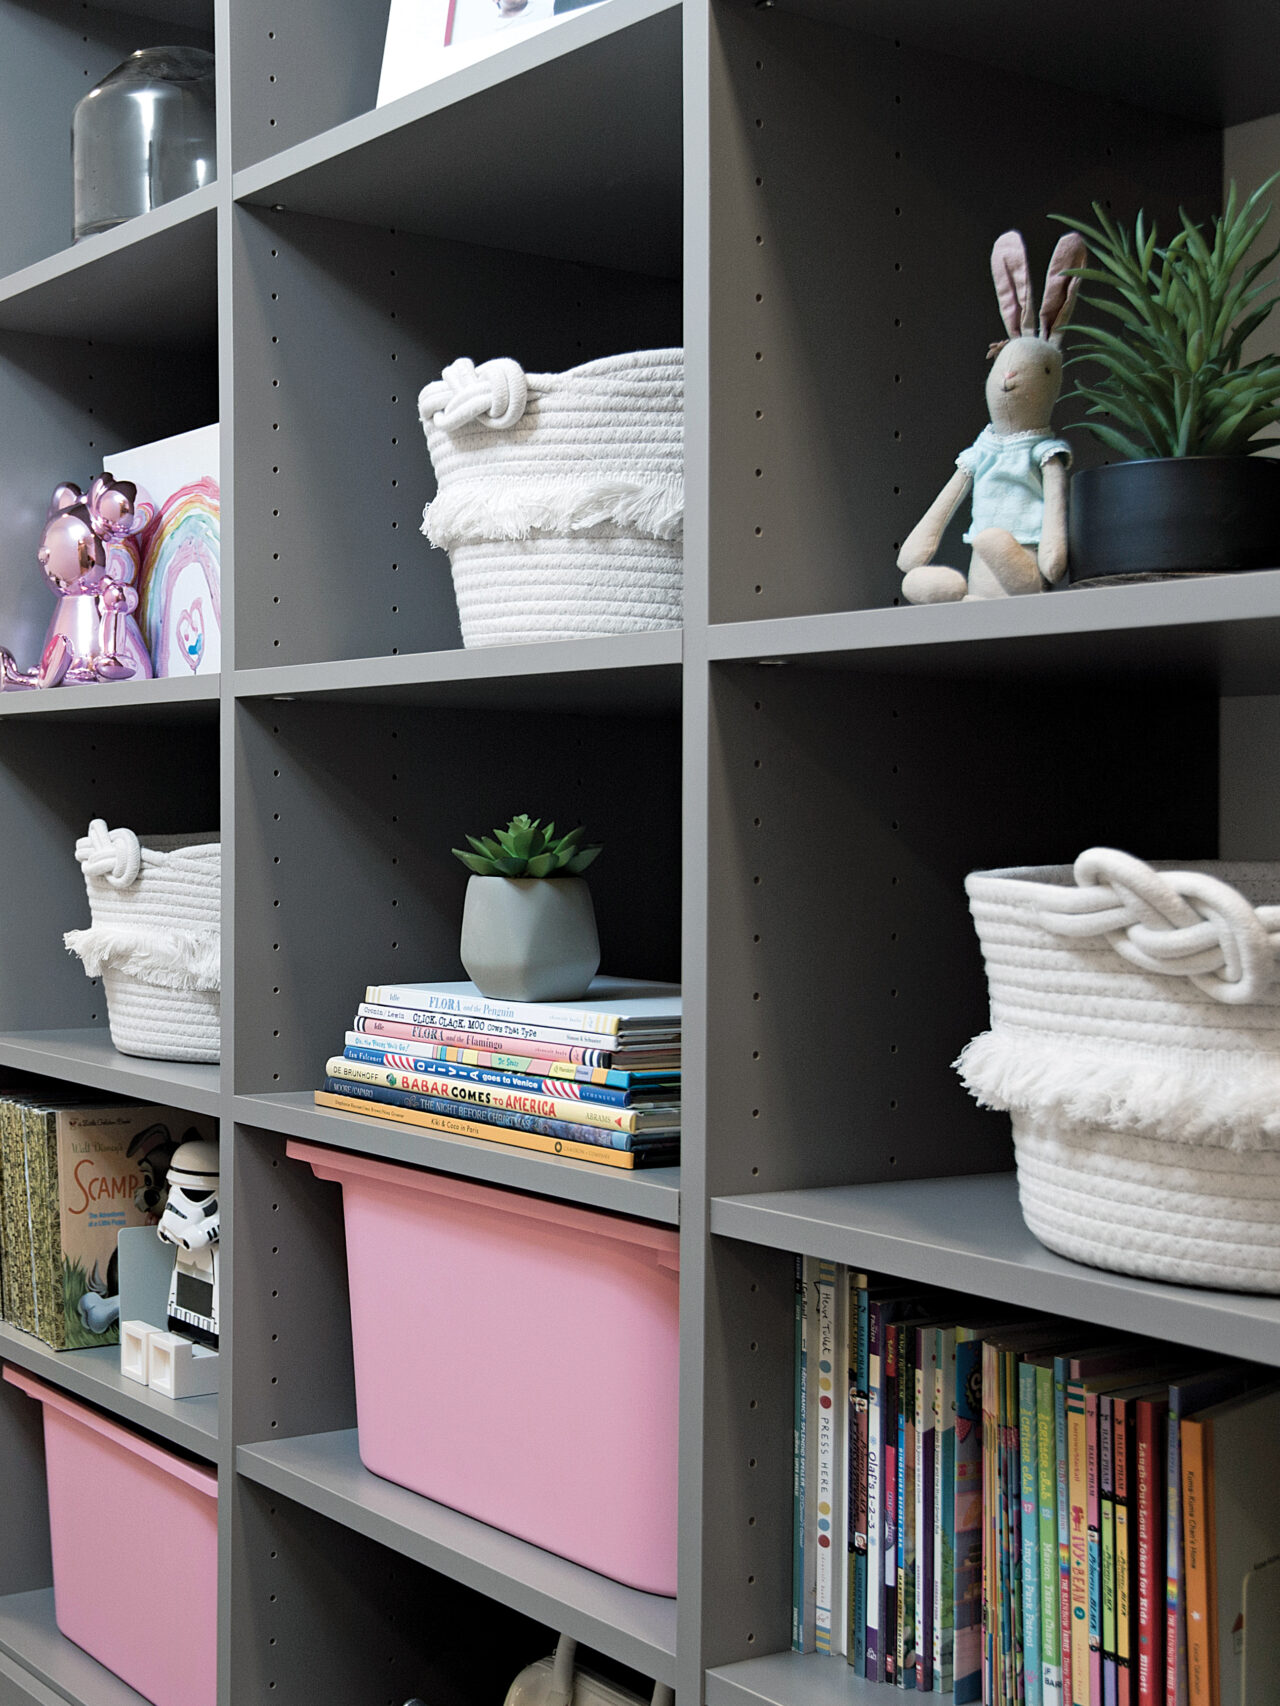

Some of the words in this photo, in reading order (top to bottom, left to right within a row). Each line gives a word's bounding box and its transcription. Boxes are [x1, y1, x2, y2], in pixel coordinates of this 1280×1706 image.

[390, 993, 400, 1001] Idle
[428, 996, 461, 1011] FLORA
[482, 1004, 514, 1018] Penguin
[374, 1023, 384, 1031] Idle
[413, 1013, 438, 1024] CLICK,
[438, 1017, 466, 1029] CLACK,
[468, 1018, 485, 1030] MOO
[372, 1039, 385, 1048] Places
[412, 1027, 444, 1041] FLORA
[466, 1033, 502, 1049] Flamingo
[348, 1050, 358, 1058] Ian
[359, 1051, 382, 1063] Falconer
[333, 1066, 341, 1074] DE
[343, 1068, 379, 1080] BRUNHOFF
[417, 1062, 479, 1080] OLIVIA
[482, 1073, 500, 1082] goes
[502, 1075, 511, 1084] to
[512, 1077, 538, 1088] Venice
[401, 1076, 450, 1096] BABAR
[451, 1087, 491, 1104] COMES
[492, 1097, 503, 1105] TO
[506, 1094, 557, 1117] AMERICA
[420, 1099, 434, 1110] THE
[436, 1100, 457, 1114] NIGHT
[459, 1104, 487, 1120] BEFORE
[488, 1110, 530, 1128] CHRISTMAS
[585, 1112, 611, 1124] ABRAMS
[447, 1121, 459, 1130] Coco
[460, 1123, 465, 1131] in
[467, 1124, 479, 1134] Paris
[68, 1159, 139, 1214] SCAMP
[822, 1324, 830, 1355] Tullet
[821, 1417, 829, 1455] PRESS
[868, 1452, 878, 1489] Olaf's
[1023, 1466, 1032, 1494] club
[1058, 1460, 1066, 1484] RUBY
[1040, 1470, 1050, 1500] club
[1138, 1443, 1148, 1538] Laugh-Out-Loud
[868, 1496, 876, 1529] 1-2-3
[1024, 1539, 1033, 1564] Amy
[1043, 1542, 1052, 1580] Marion
[1072, 1535, 1085, 1562] IVY
[1139, 1541, 1148, 1575] Jokes
[1024, 1568, 1032, 1581] on
[1072, 1567, 1085, 1604] BEAN
[1140, 1577, 1148, 1593] for
[1025, 1585, 1034, 1609] Park
[1044, 1584, 1053, 1615] Takes
[1140, 1598, 1148, 1625] Kids
[1025, 1613, 1034, 1648] Patrol
[1043, 1619, 1054, 1656] Charge
[1140, 1654, 1148, 1694] Elliott
